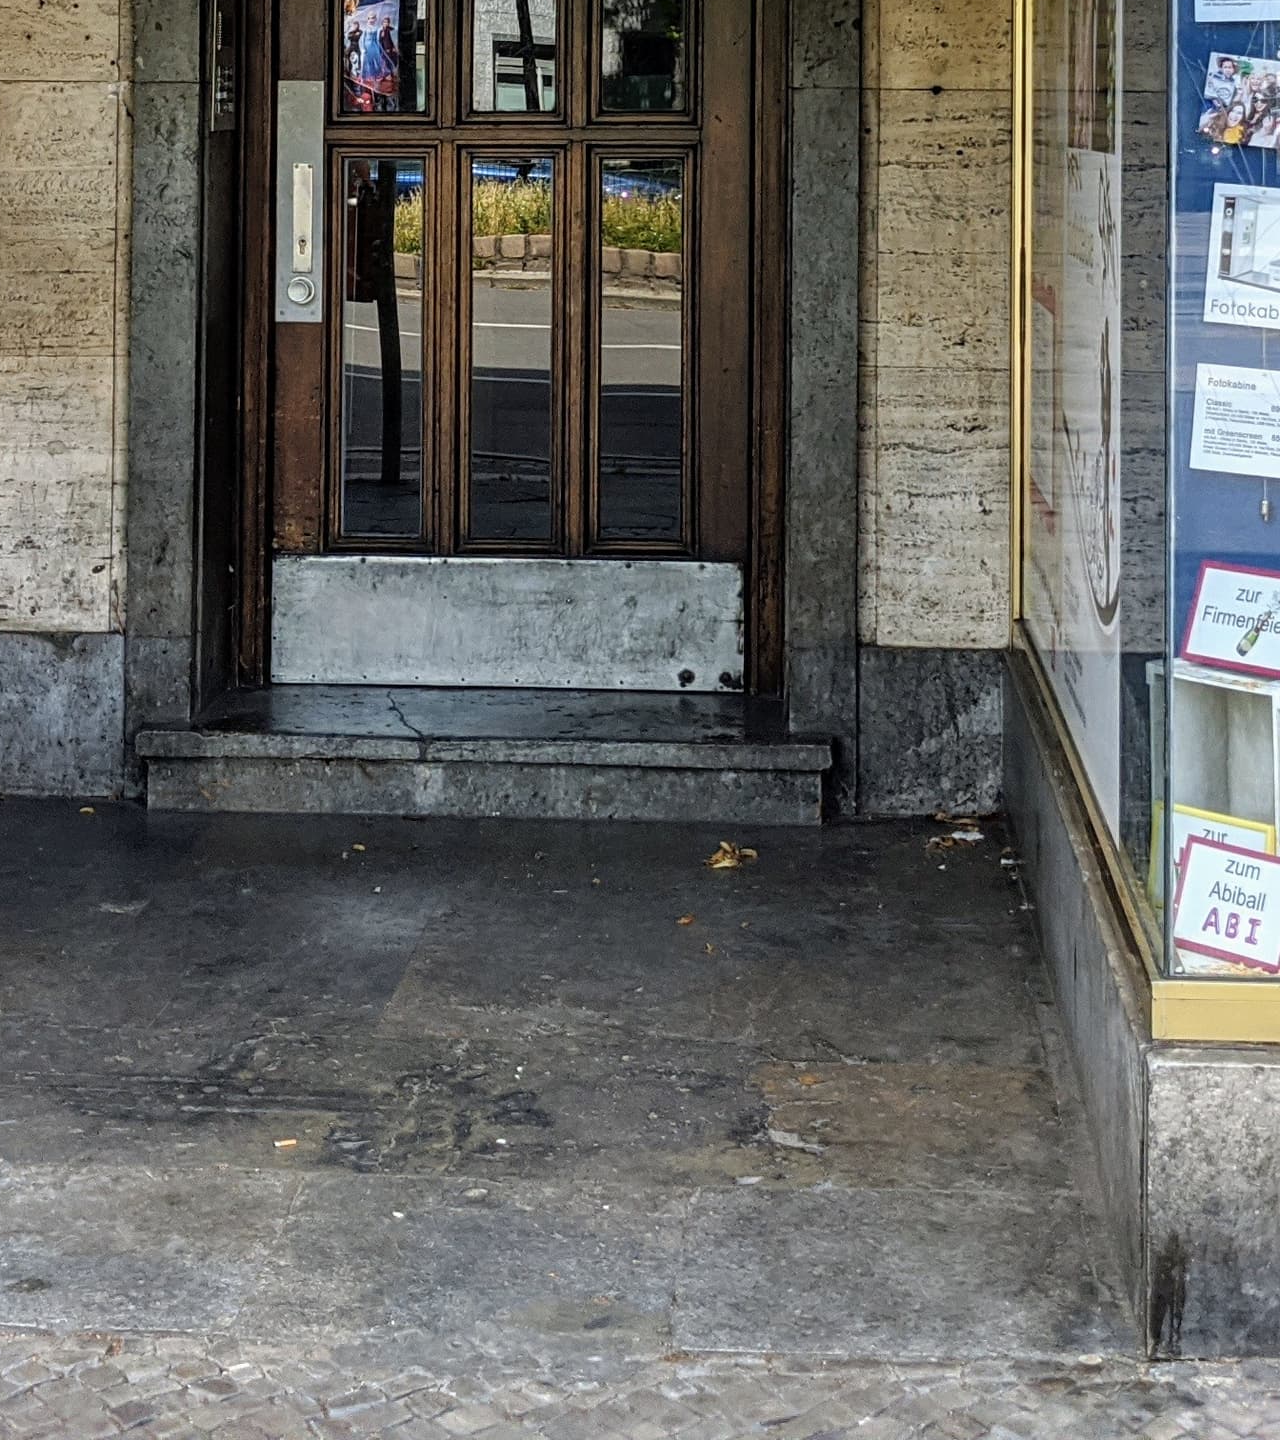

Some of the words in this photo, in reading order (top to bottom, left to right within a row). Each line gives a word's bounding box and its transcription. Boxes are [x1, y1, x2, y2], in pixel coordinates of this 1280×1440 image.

[1207, 377, 1256, 390] Fotokabine
[1236, 588, 1263, 604] zur
[1224, 859, 1261, 880] zum
[1208, 881, 1266, 912] Abiball
[1202, 907, 1262, 946] ABI
